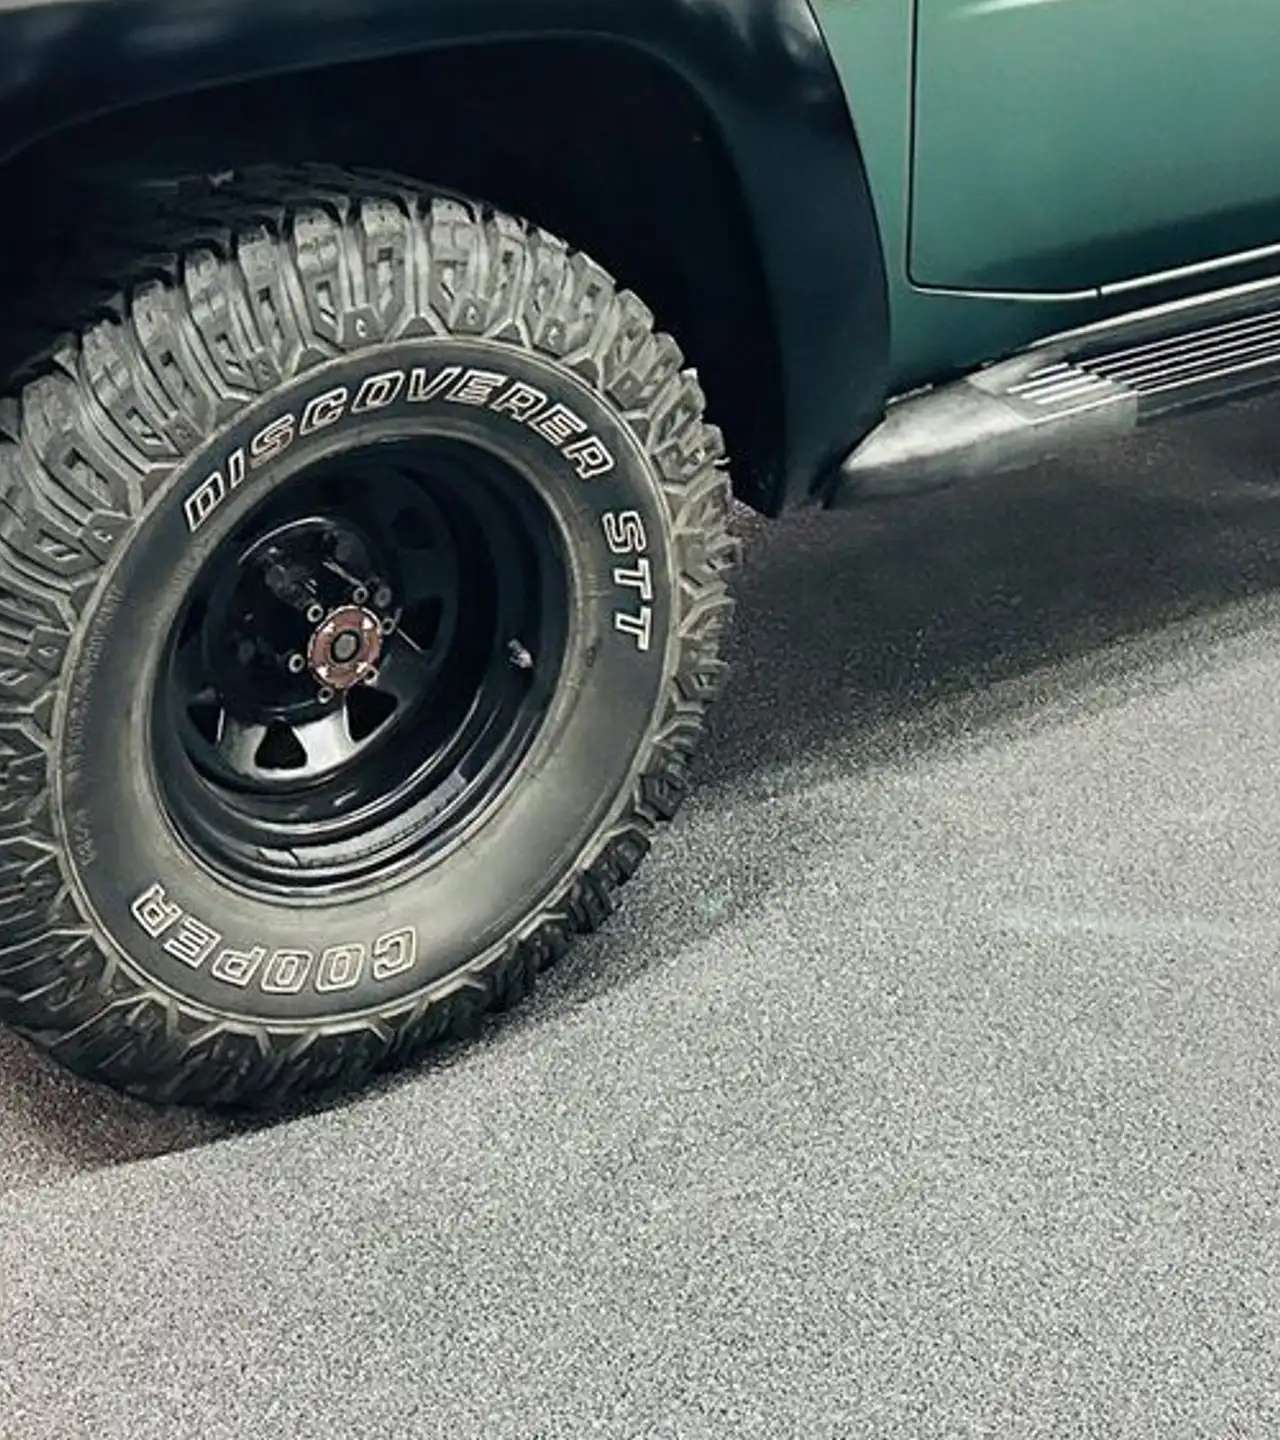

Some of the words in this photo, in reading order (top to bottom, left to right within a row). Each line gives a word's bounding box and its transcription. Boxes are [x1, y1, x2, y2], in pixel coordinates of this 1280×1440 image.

[184, 366, 615, 533] DISCOVERER
[603, 510, 654, 651] STT
[131, 883, 417, 994] COOPER
